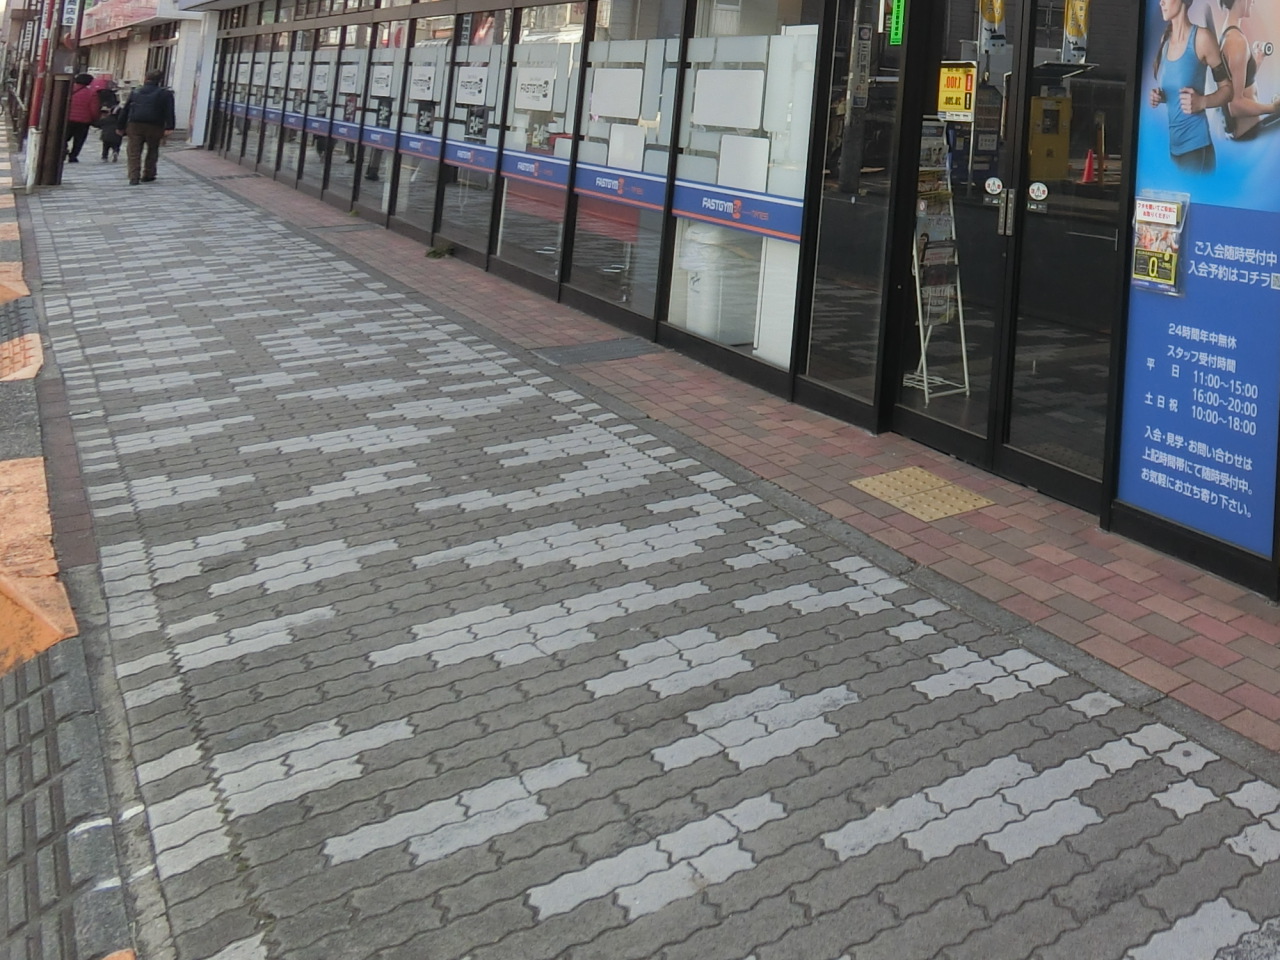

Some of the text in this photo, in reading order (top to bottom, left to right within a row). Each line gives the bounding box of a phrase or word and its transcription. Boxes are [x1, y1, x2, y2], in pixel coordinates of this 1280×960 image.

[701, 196, 734, 214] FASTGYM
[1194, 241, 1278, 267] ご入会随時受付中
[1188, 260, 1271, 287] 入会予約はコチラ
[1168, 323, 1238, 350] 24時間年中無休
[1166, 344, 1237, 374] スタッフ受付時間
[1144, 425, 1253, 471] 入会・見学・お問い合わせは
[1142, 446, 1253, 496] 上記時間帯にて随時受付中。
[1141, 467, 1252, 519] お気軽にお立ち寄り下さい。
